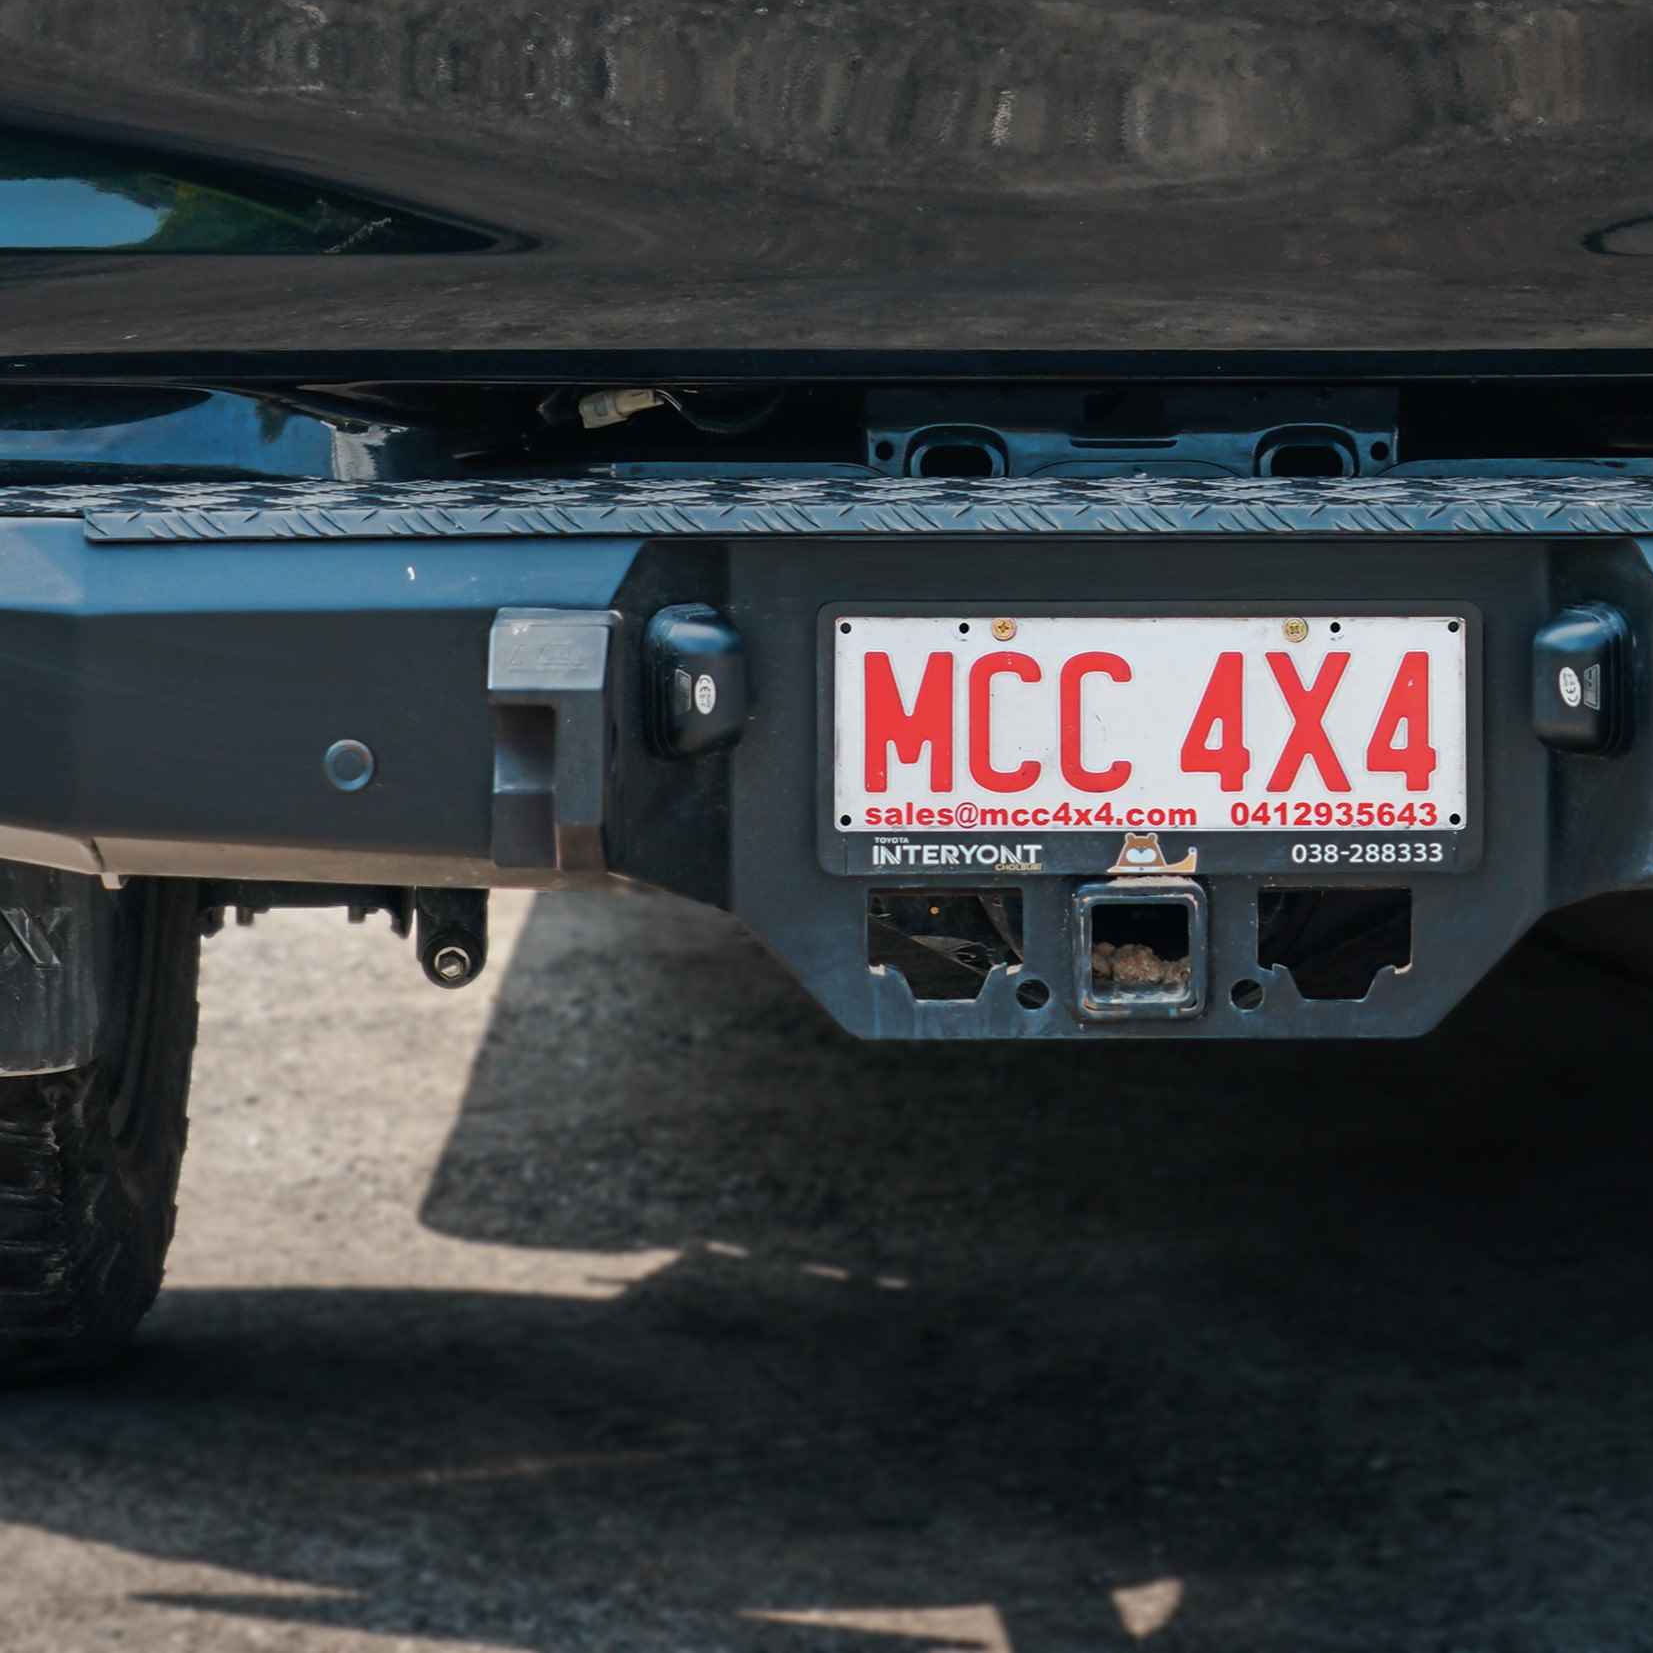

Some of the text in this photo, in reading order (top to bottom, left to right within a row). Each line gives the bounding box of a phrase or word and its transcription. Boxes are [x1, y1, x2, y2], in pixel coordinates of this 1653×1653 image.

[864, 651, 1437, 793] MCC 4X4
[865, 802, 1438, 827] sales@mcc4x4.com 0412935643
[874, 836, 910, 844] TOYOTA
[872, 842, 1443, 865] INTERYONT 038-288333
